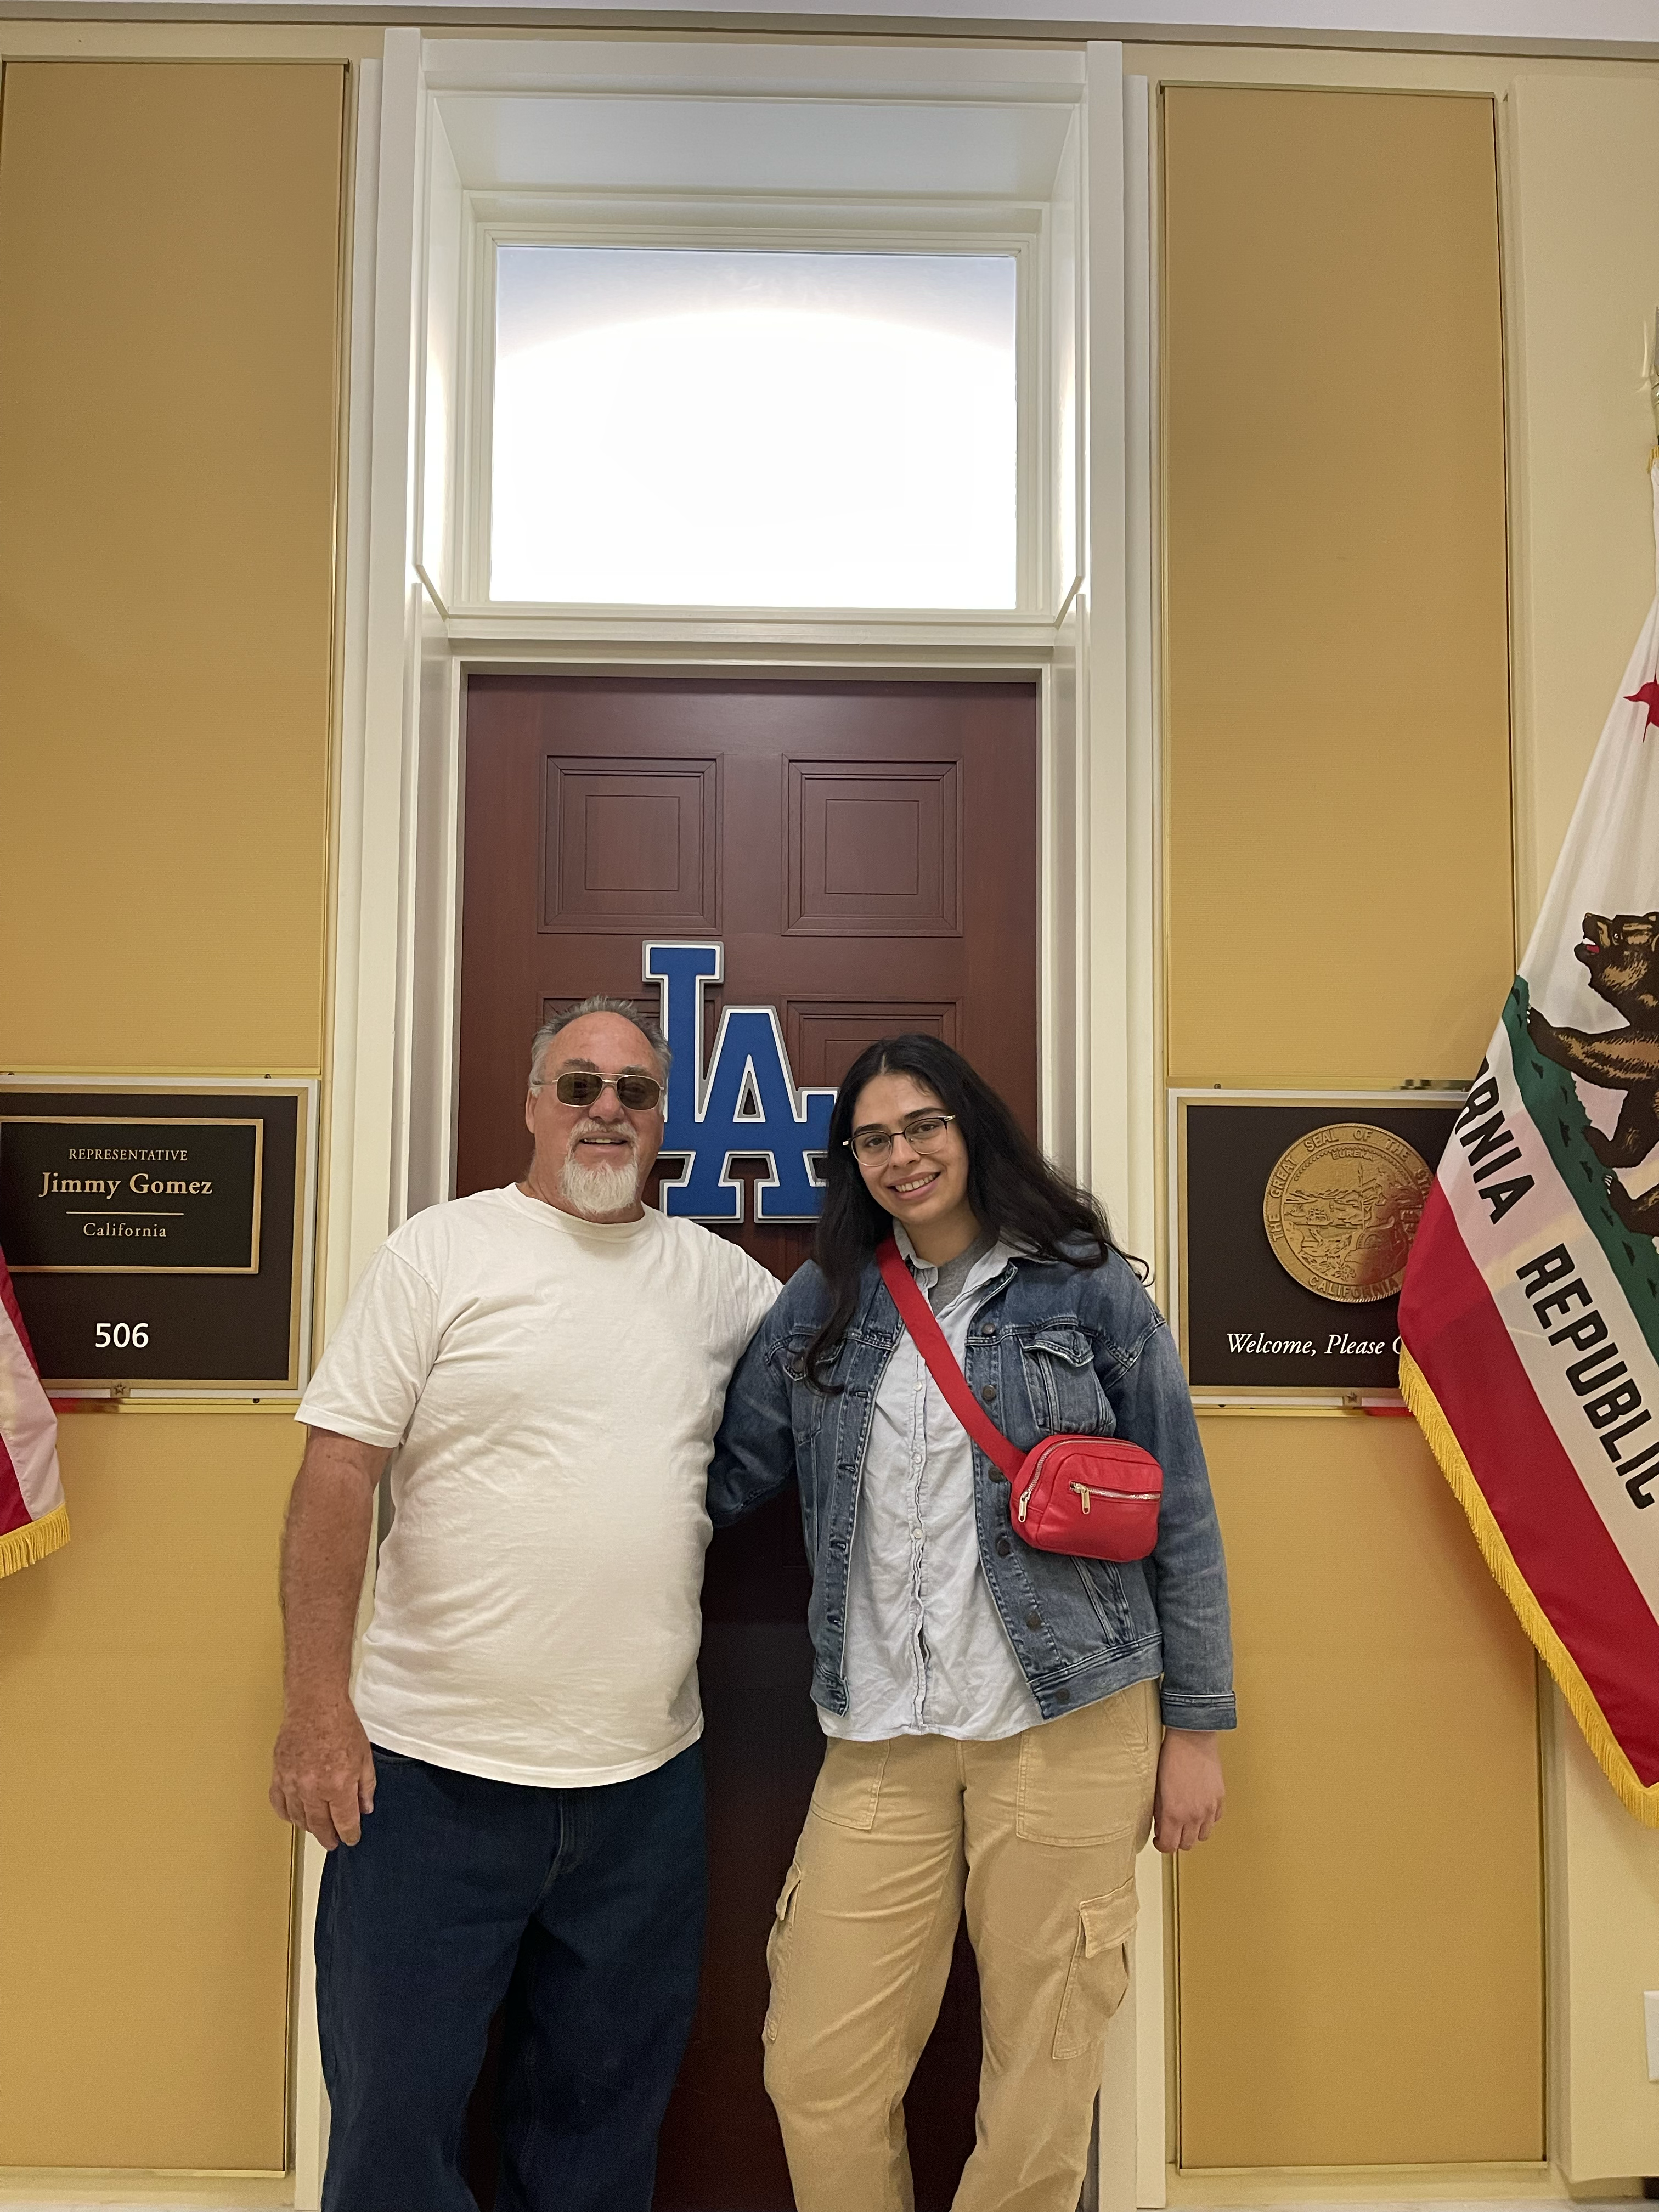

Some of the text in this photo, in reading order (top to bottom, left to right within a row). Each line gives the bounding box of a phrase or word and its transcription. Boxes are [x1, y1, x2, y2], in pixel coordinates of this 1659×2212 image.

[642, 940, 838, 1223] LA
[69, 1148, 188, 1161] REPRESENTATIVE
[1331, 1150, 1373, 1161] EUREKA
[38, 1172, 213, 1199] Jimmy Gomez
[1268, 1128, 1412, 1242] THE GREAT SEAL OF THE
[83, 1222, 167, 1237] California
[1455, 1056, 1659, 1509] RNIA REPUBLIC
[95, 1323, 149, 1348] 506
[1226, 1333, 1317, 1357] Welcome,
[1324, 1333, 1385, 1355] Please
